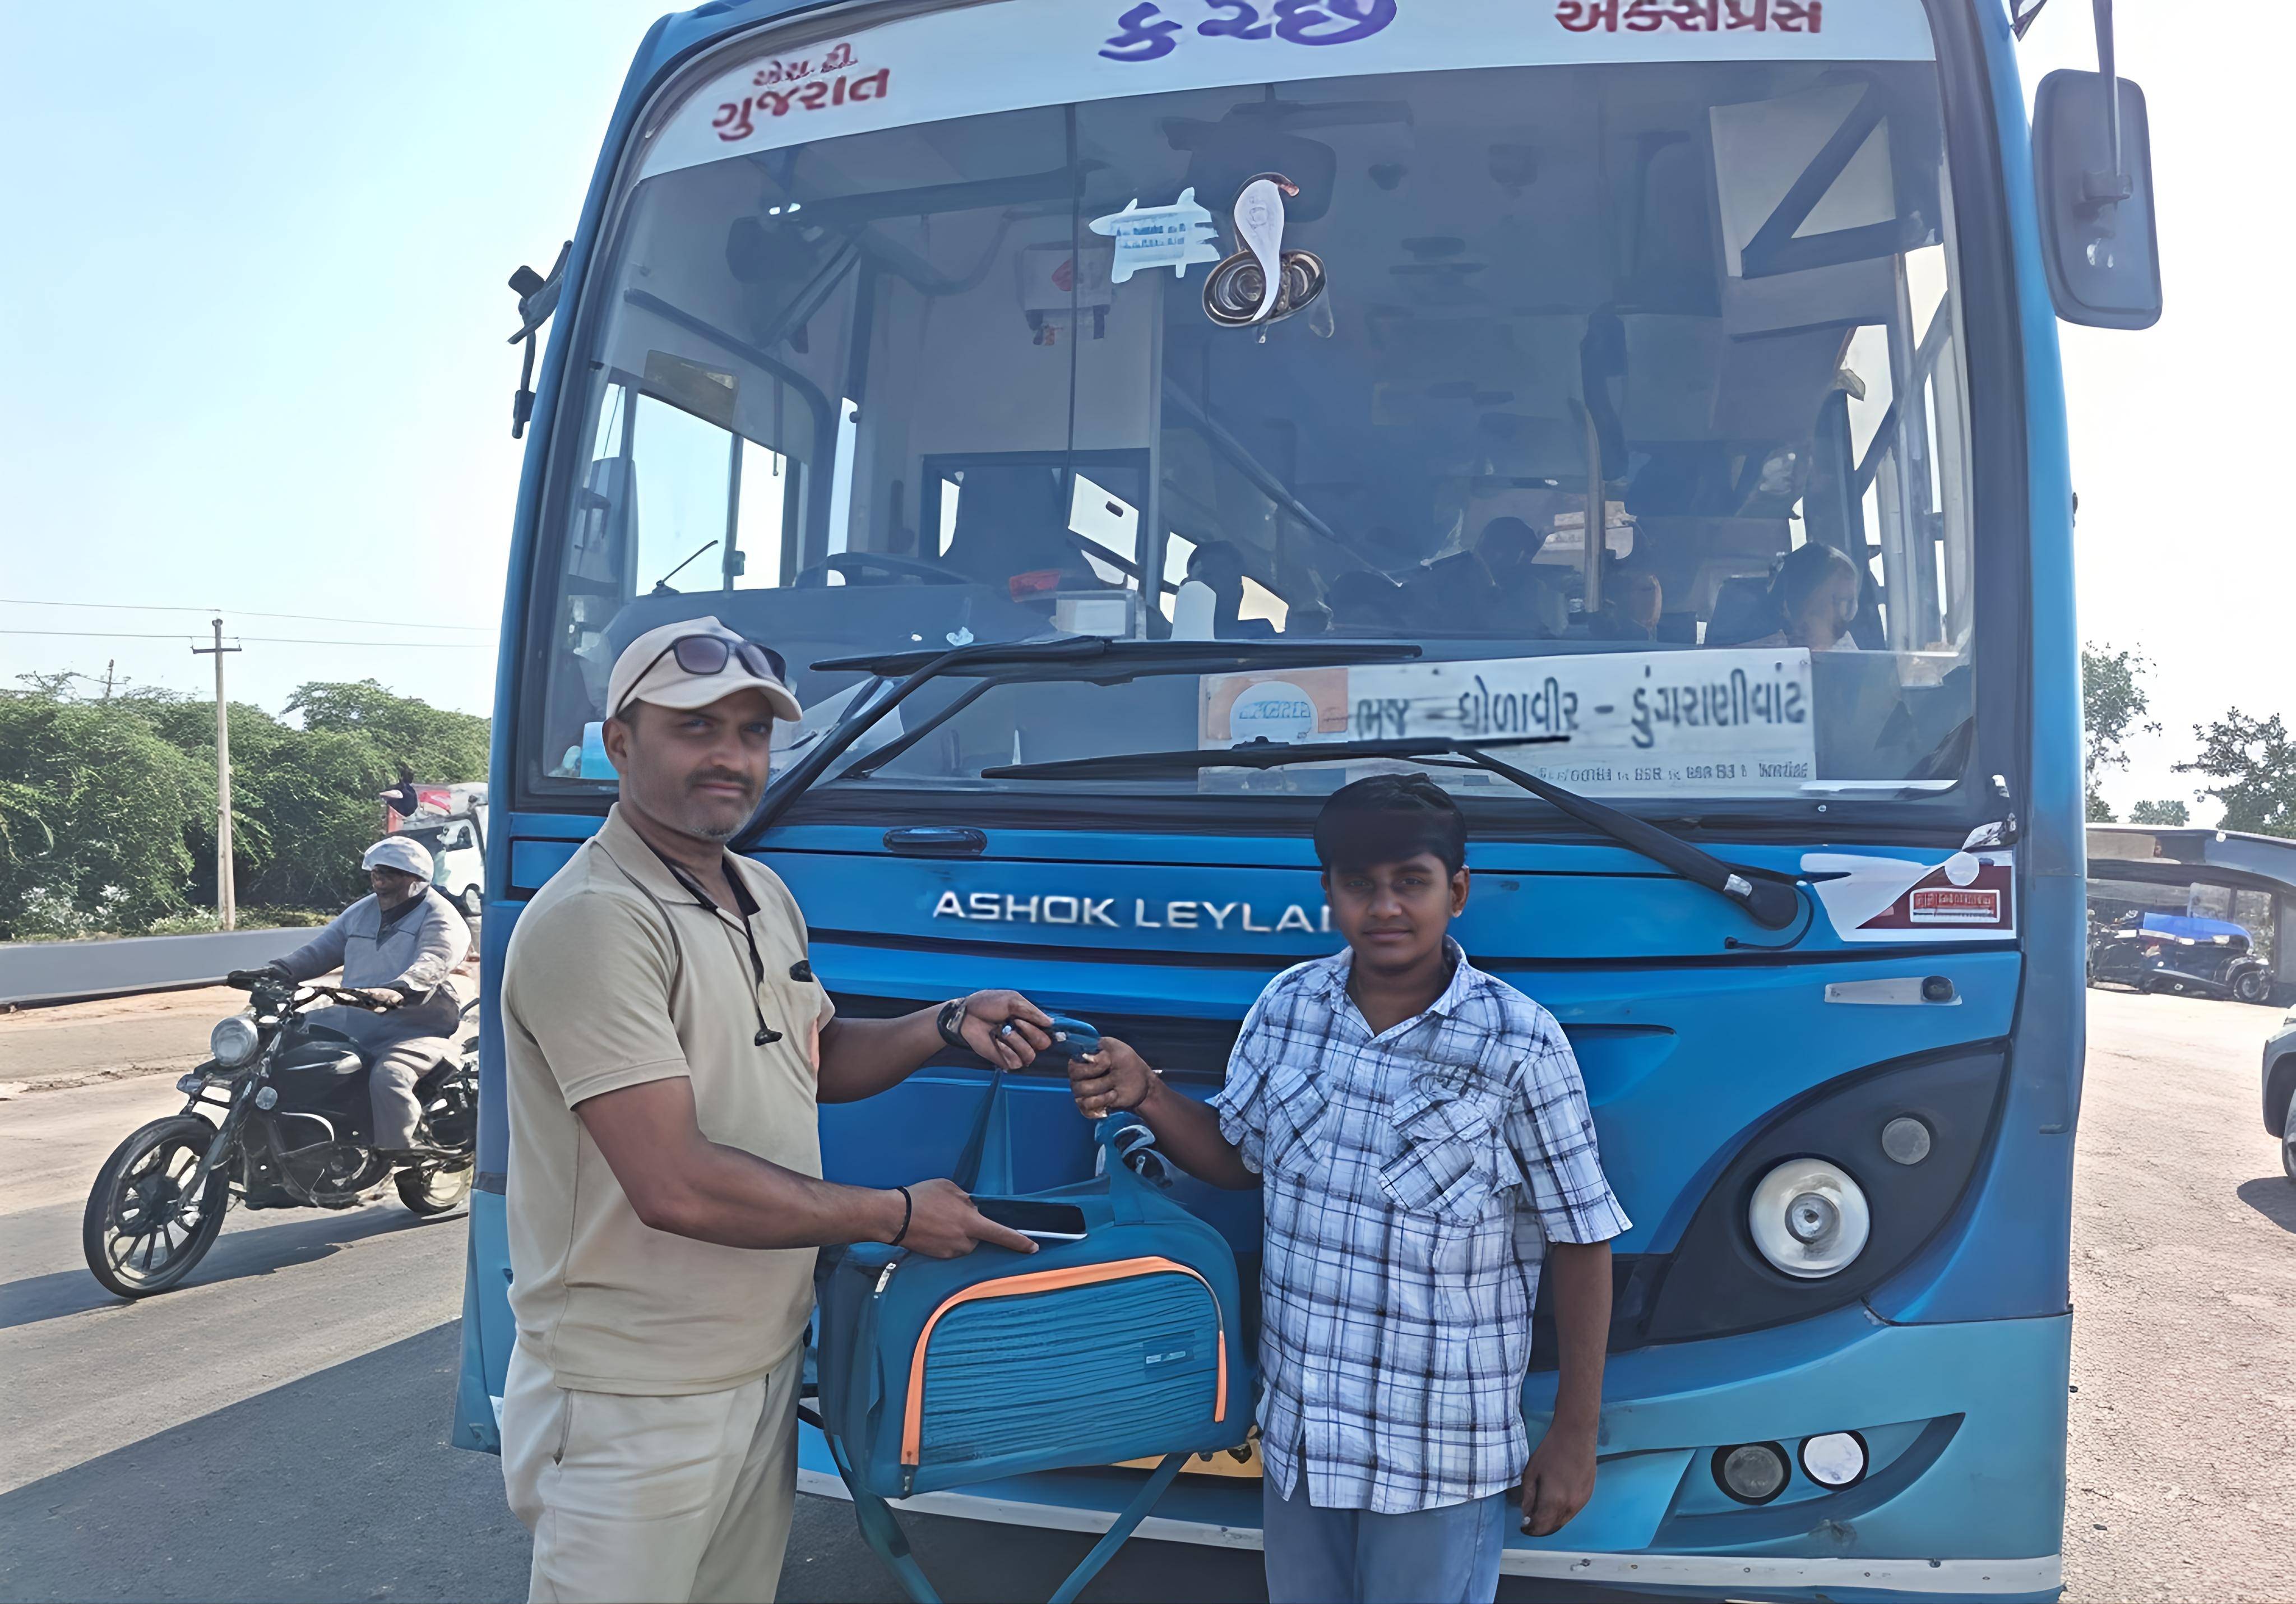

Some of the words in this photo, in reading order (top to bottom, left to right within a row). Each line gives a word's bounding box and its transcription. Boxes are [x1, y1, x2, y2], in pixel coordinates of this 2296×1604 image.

[712, 68, 890, 142] ગુજરાત
[933, 890, 1121, 928] ASHOK
[1135, 898, 1331, 933] LEYLA
